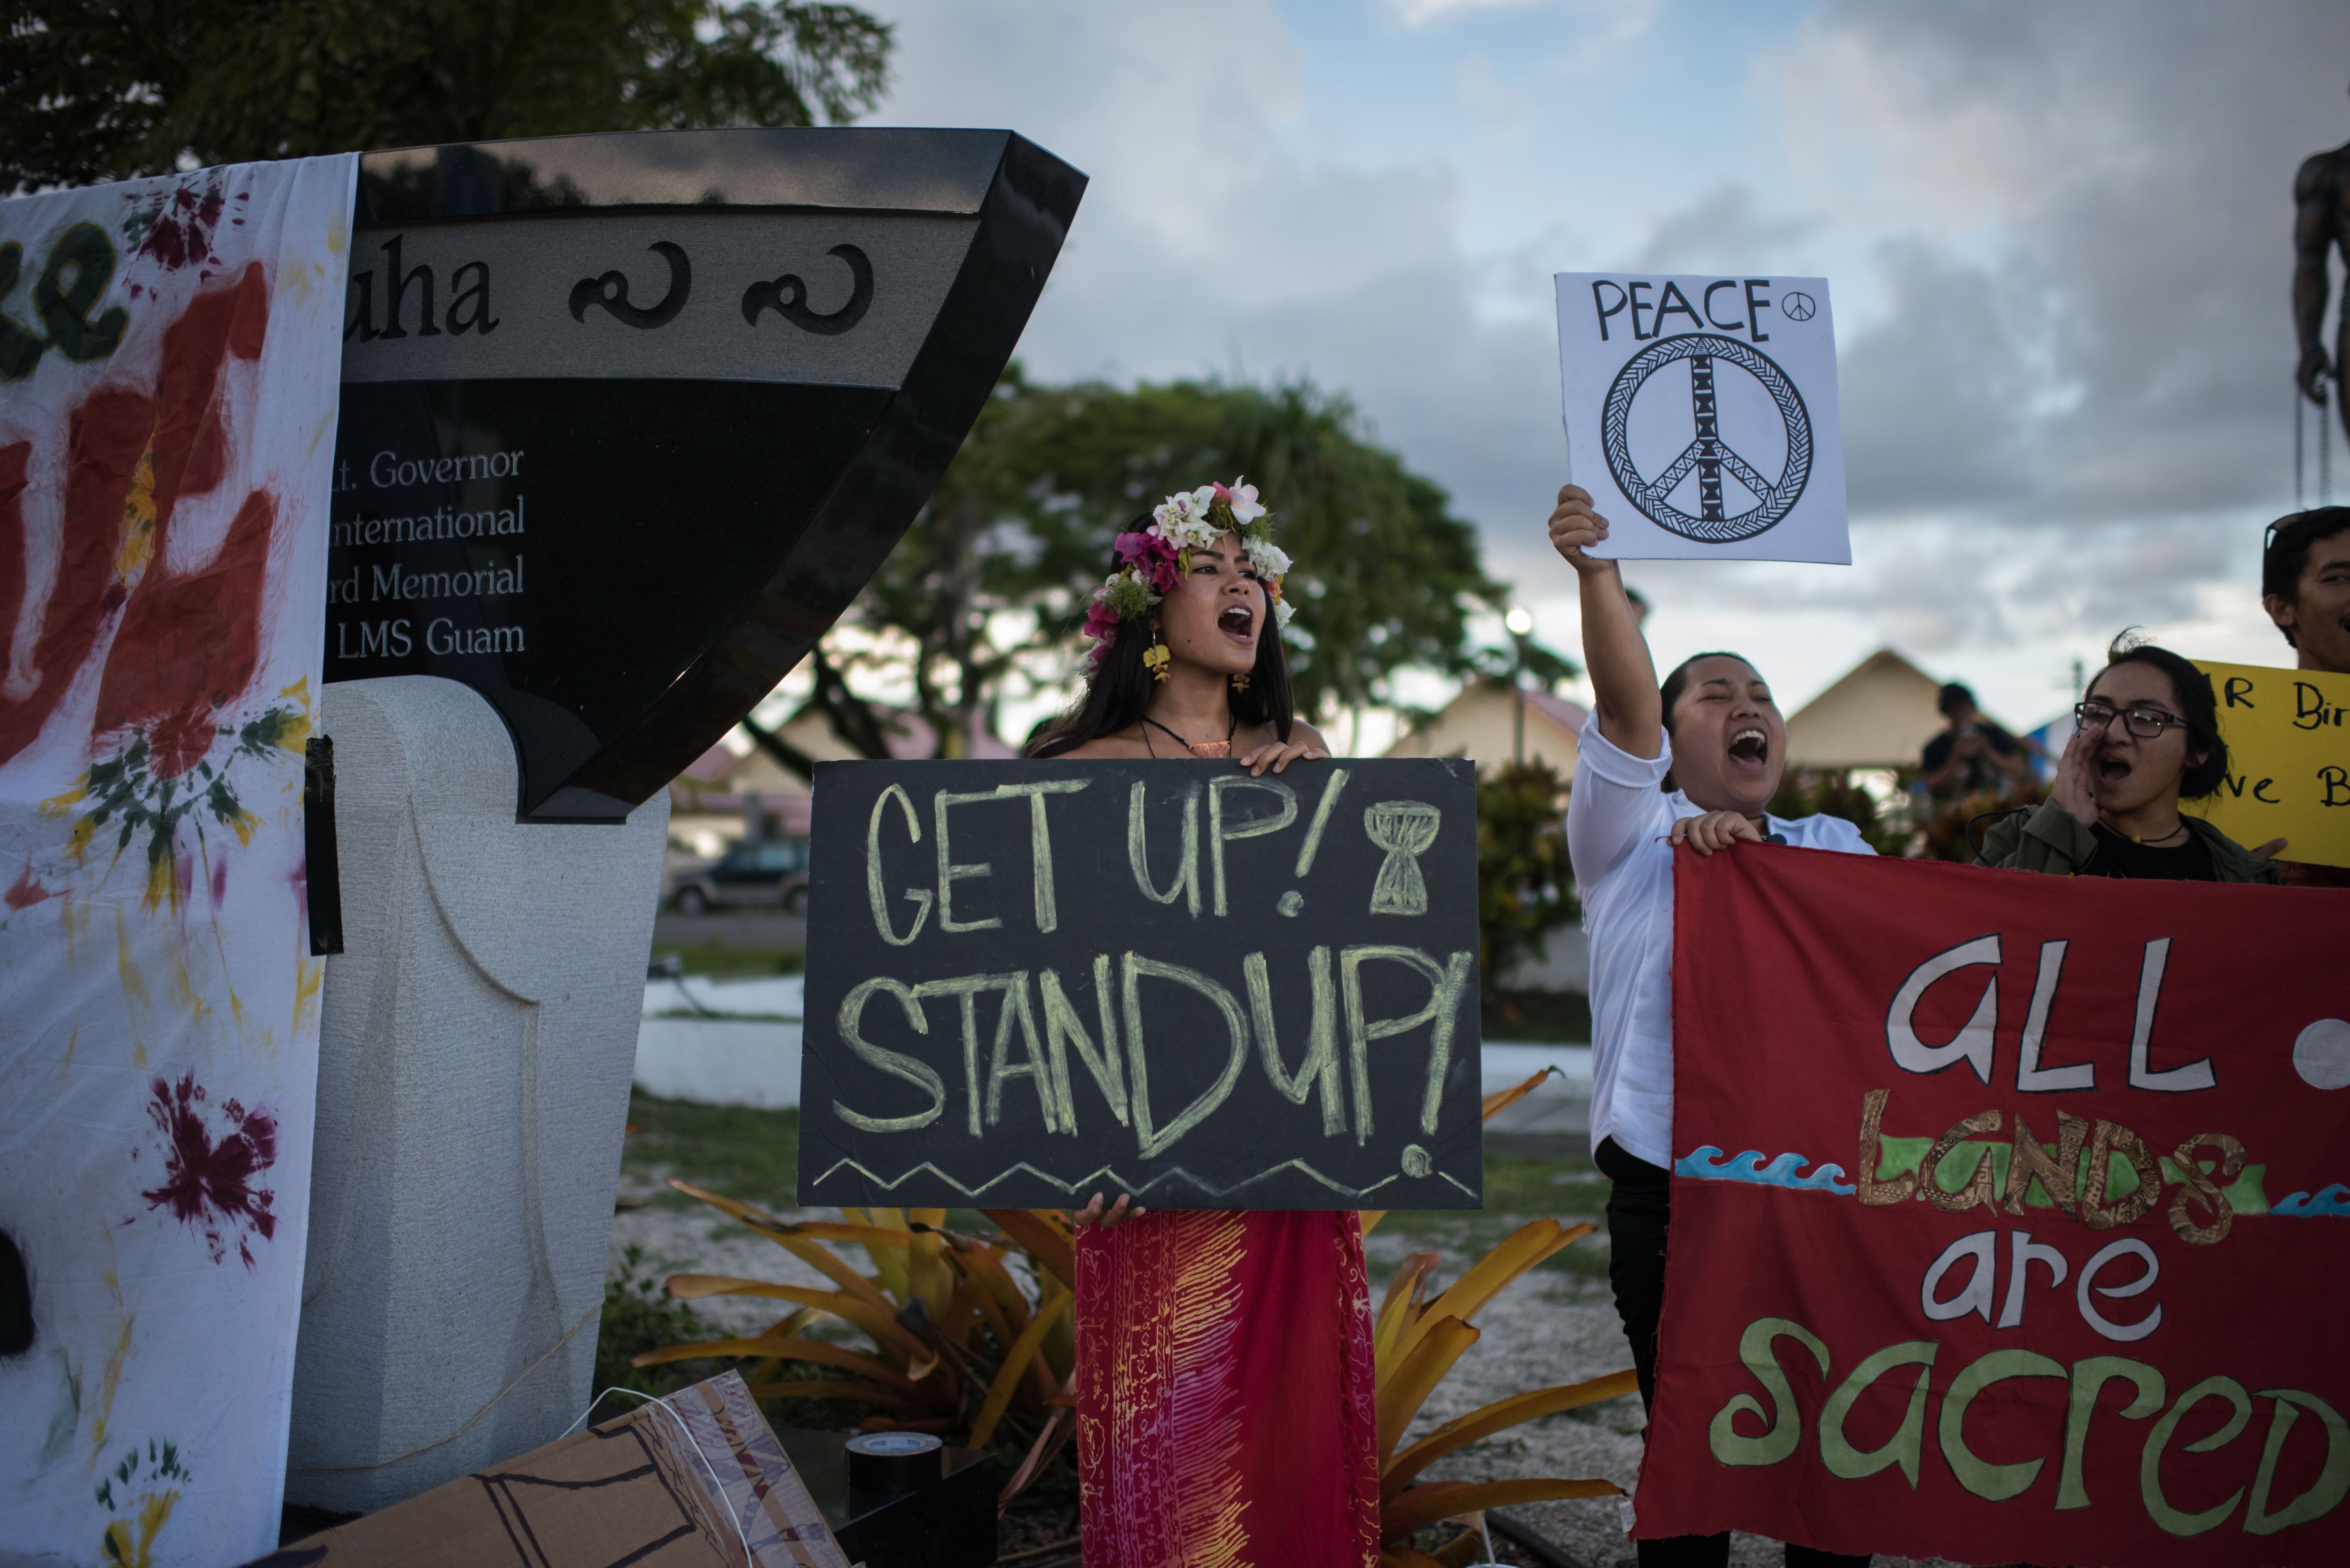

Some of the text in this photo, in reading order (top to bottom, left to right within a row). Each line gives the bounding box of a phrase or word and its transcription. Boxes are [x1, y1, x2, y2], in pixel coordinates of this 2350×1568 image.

[1592, 280, 1770, 342] PEACE
[332, 449, 525, 492] t. Governor
[329, 493, 525, 548] nternational
[371, 553, 524, 602] Memorial
[338, 616, 525, 659] LMS Guam
[867, 768, 1351, 946] GET UP!
[1920, 1229, 2162, 1342] are
